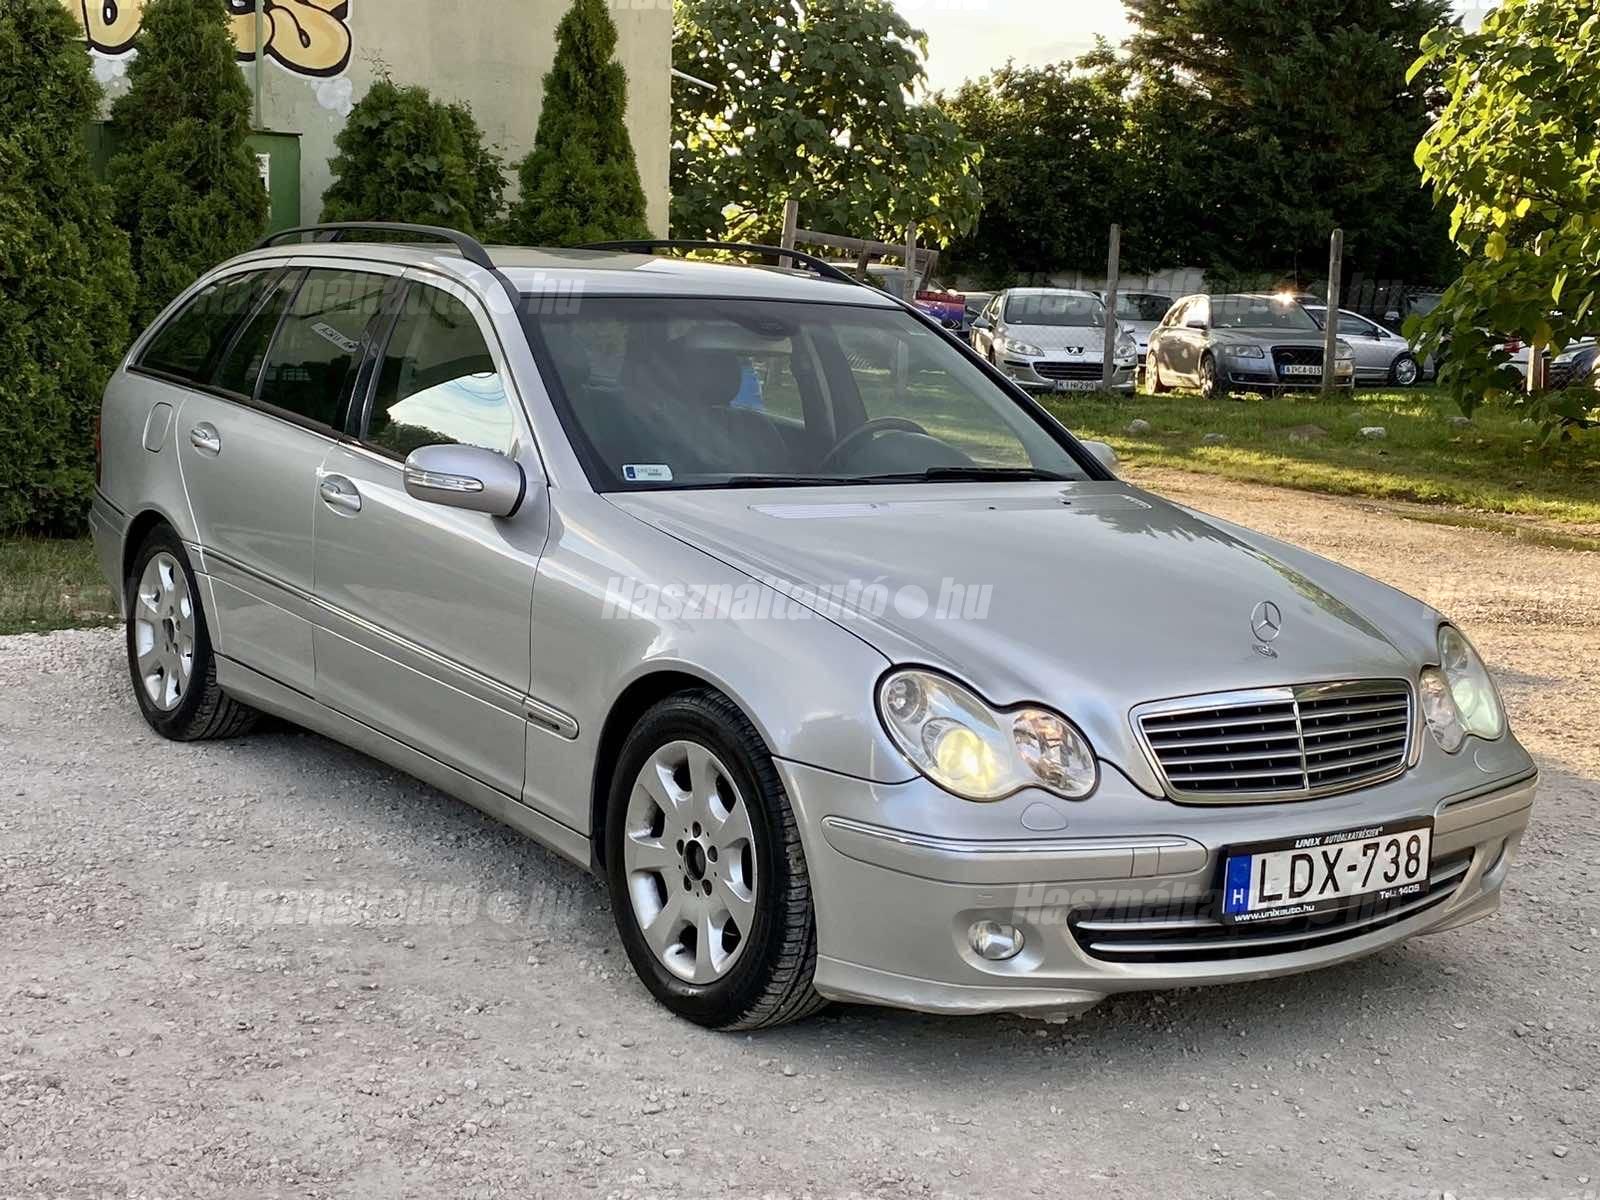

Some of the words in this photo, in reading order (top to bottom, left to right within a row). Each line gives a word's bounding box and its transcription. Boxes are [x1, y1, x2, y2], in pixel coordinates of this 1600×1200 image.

[1295, 837, 1321, 848] UNIX
[1258, 834, 1421, 904] LDX-738
[1232, 888, 1244, 906] H
[1234, 904, 1315, 922] www.unixauto.hu
